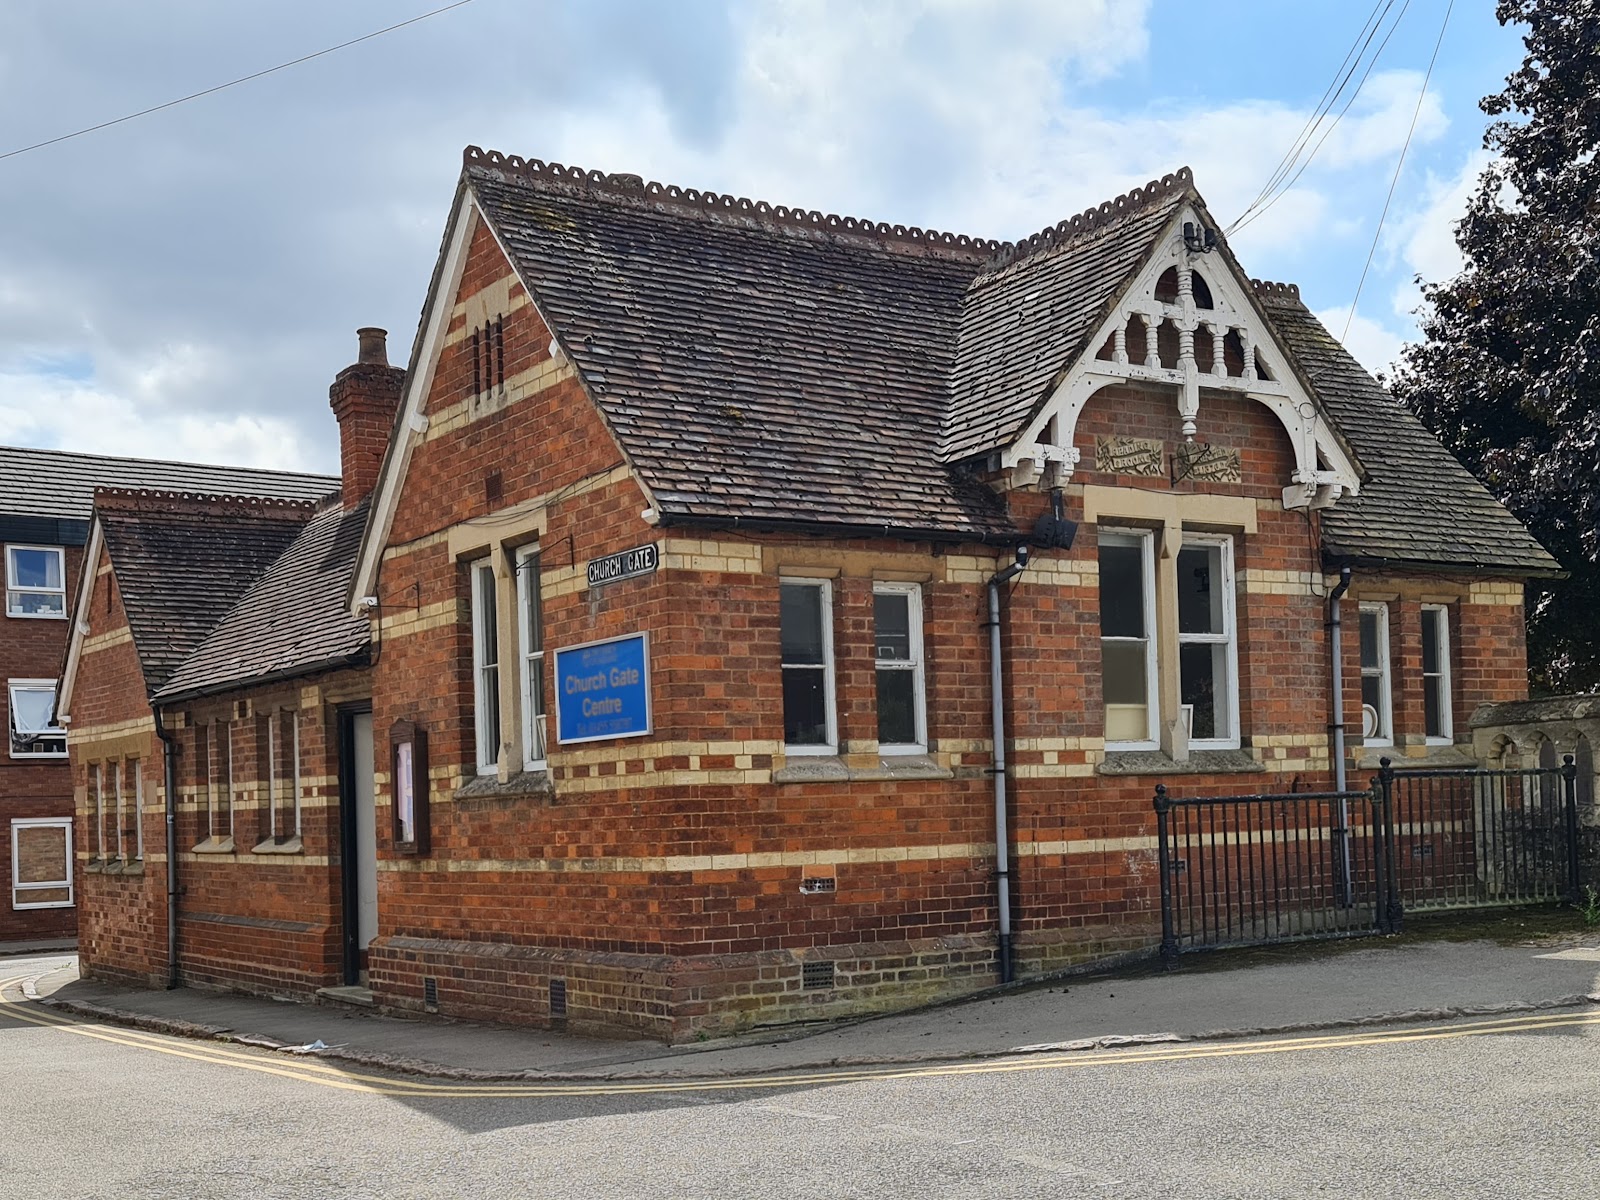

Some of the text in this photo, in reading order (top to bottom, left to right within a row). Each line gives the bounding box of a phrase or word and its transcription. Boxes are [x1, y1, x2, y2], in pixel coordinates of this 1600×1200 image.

[589, 549, 651, 581] CHURCH GATE
[566, 667, 638, 694] Church Gate
[583, 697, 622, 716] Centre
